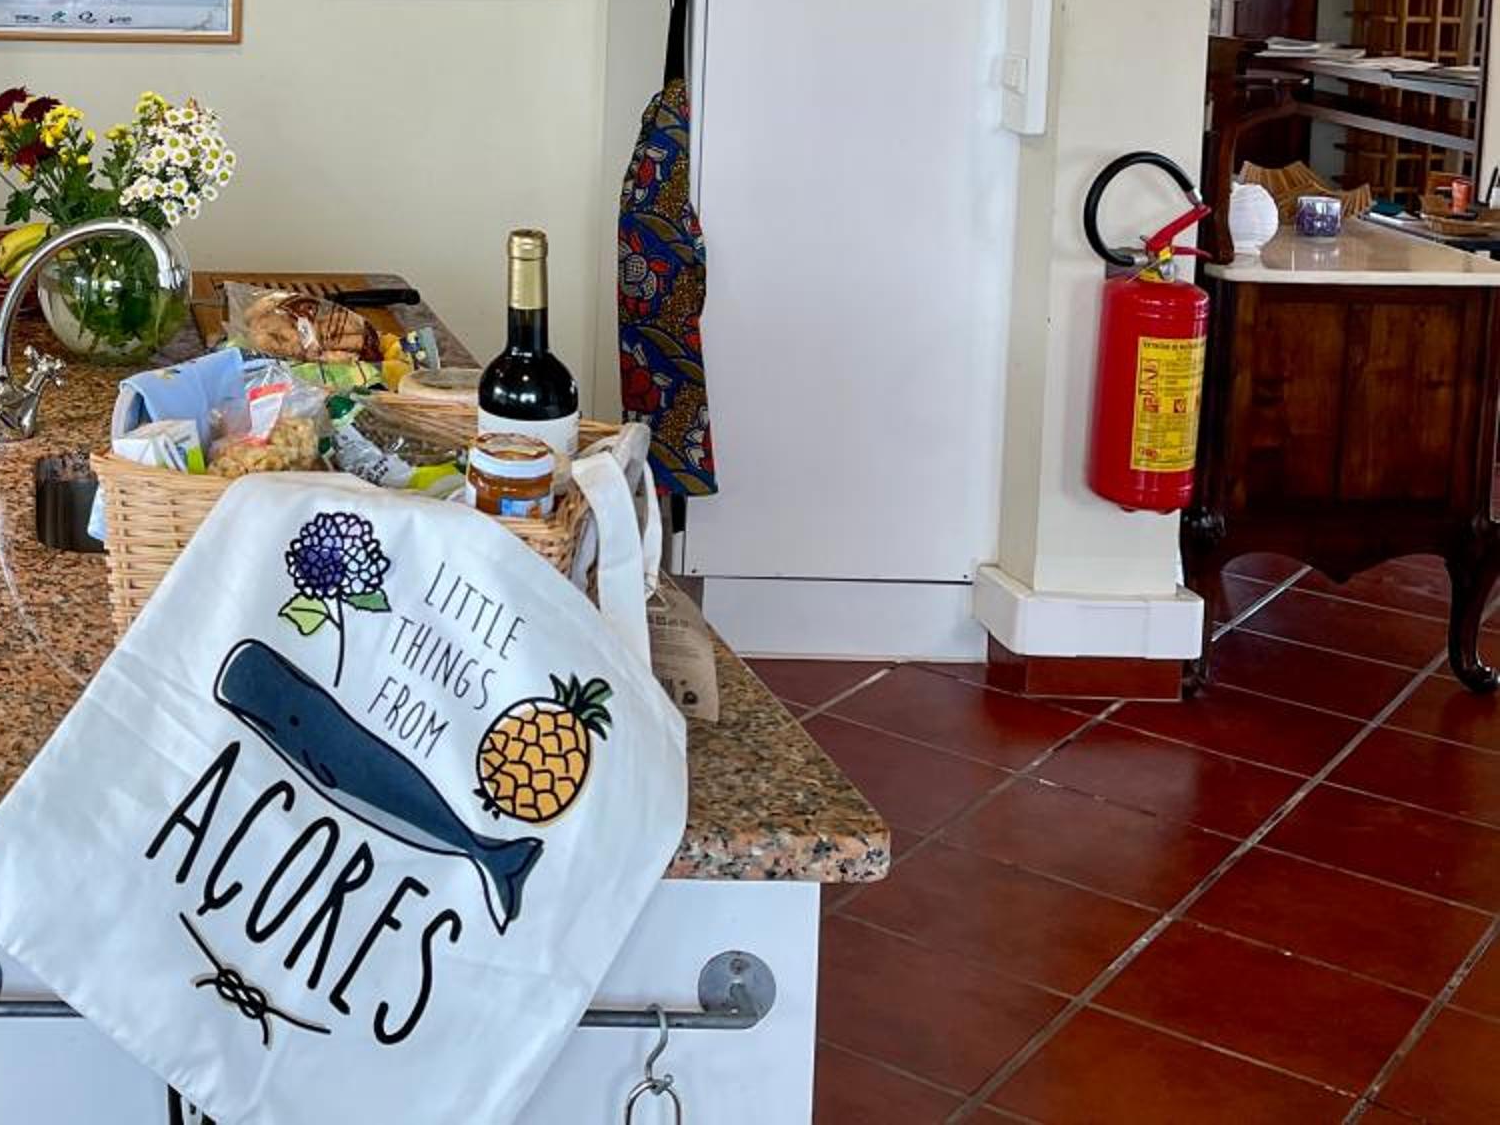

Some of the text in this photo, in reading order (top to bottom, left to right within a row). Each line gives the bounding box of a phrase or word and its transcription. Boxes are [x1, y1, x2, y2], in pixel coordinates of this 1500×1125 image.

[424, 561, 527, 661] LITTLE
[389, 615, 497, 711] THINGS
[367, 675, 450, 759] FROM
[145, 740, 462, 1045] AÇORES
